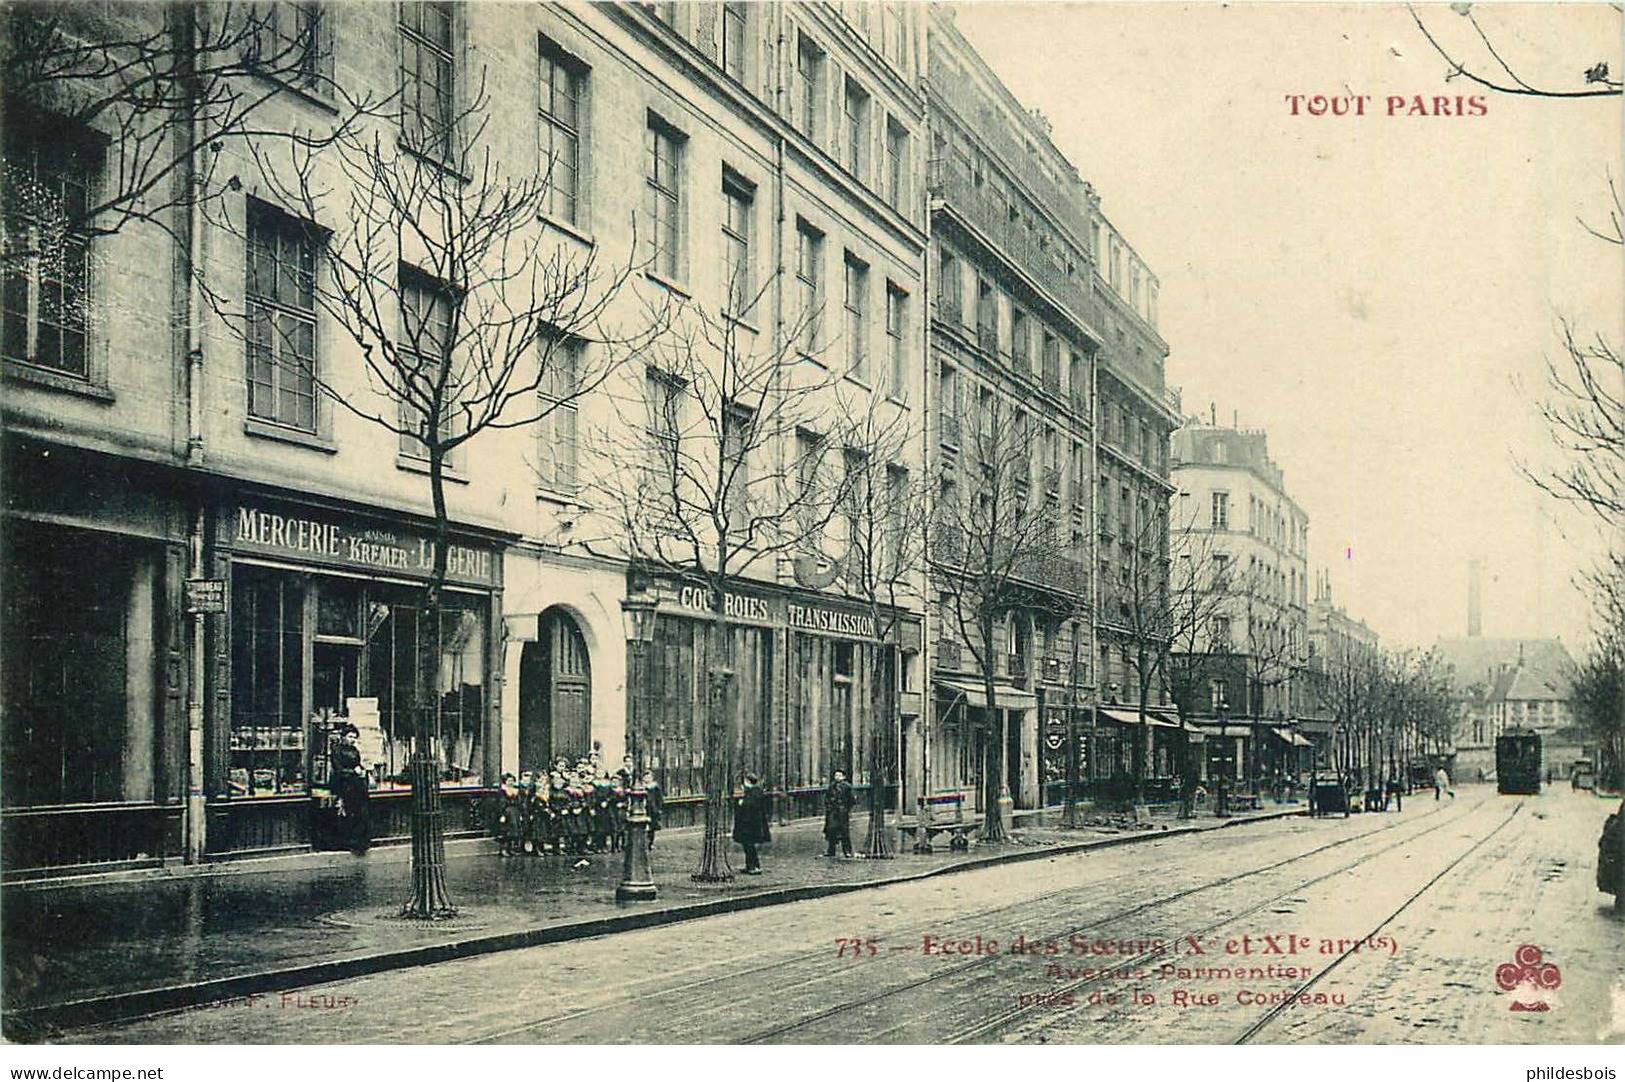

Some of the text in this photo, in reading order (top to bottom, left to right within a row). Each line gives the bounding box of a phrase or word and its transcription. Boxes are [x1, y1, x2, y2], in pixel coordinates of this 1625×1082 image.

[237, 507, 341, 557] MERCERIE
[348, 536, 409, 569] KREMER
[416, 537, 491, 577] LIGERIE
[681, 586, 874, 636] COUROIES TRANSMISSION
